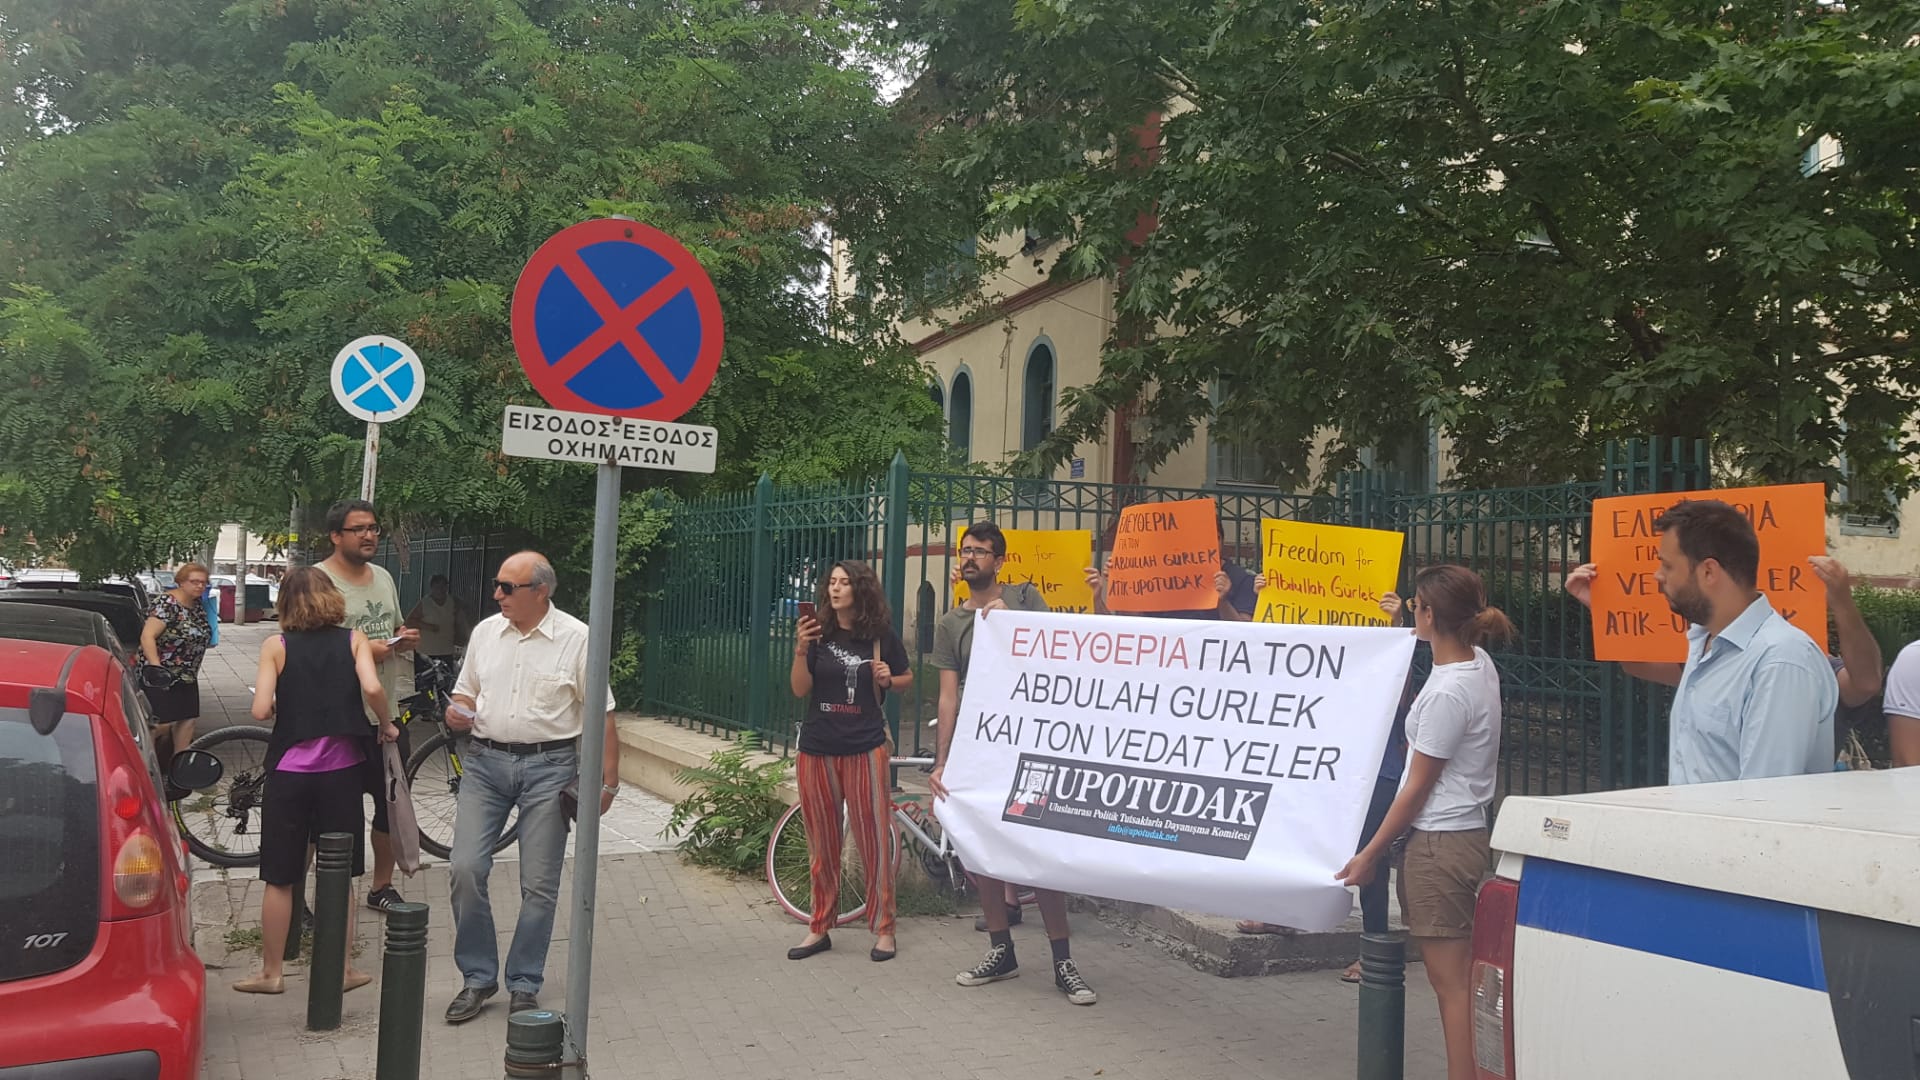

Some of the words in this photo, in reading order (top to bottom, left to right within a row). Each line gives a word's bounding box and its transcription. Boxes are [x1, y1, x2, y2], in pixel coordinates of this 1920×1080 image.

[508, 411, 713, 448] ΕΙΣΟΔΟΣ-ΕΞΟΔΟΣ
[547, 438, 676, 466] ΟΧΗΜΑΤΩΝ
[1034, 544, 1056, 563] for
[1268, 528, 1345, 566] Freedom
[1355, 547, 1373, 570] for
[1268, 568, 1326, 597] Abdullah
[1011, 627, 1189, 669] ΕΛΕΥΘΕΡΙΑ
[1198, 638, 1251, 674] ΓΙΑ
[1264, 641, 1346, 680] ΤΟΝ
[1010, 671, 1160, 715] ABDULAH
[1169, 685, 1325, 729] GURLEK
[1033, 718, 1094, 755] ΤΟΝ
[1105, 726, 1214, 769] VEDAT
[1223, 738, 1341, 781] YELER
[1054, 766, 1265, 827] UPOTUDAK
[1093, 808, 1119, 821] Politik
[1211, 826, 1253, 841] Komitesi
[23, 932, 68, 949] 107
